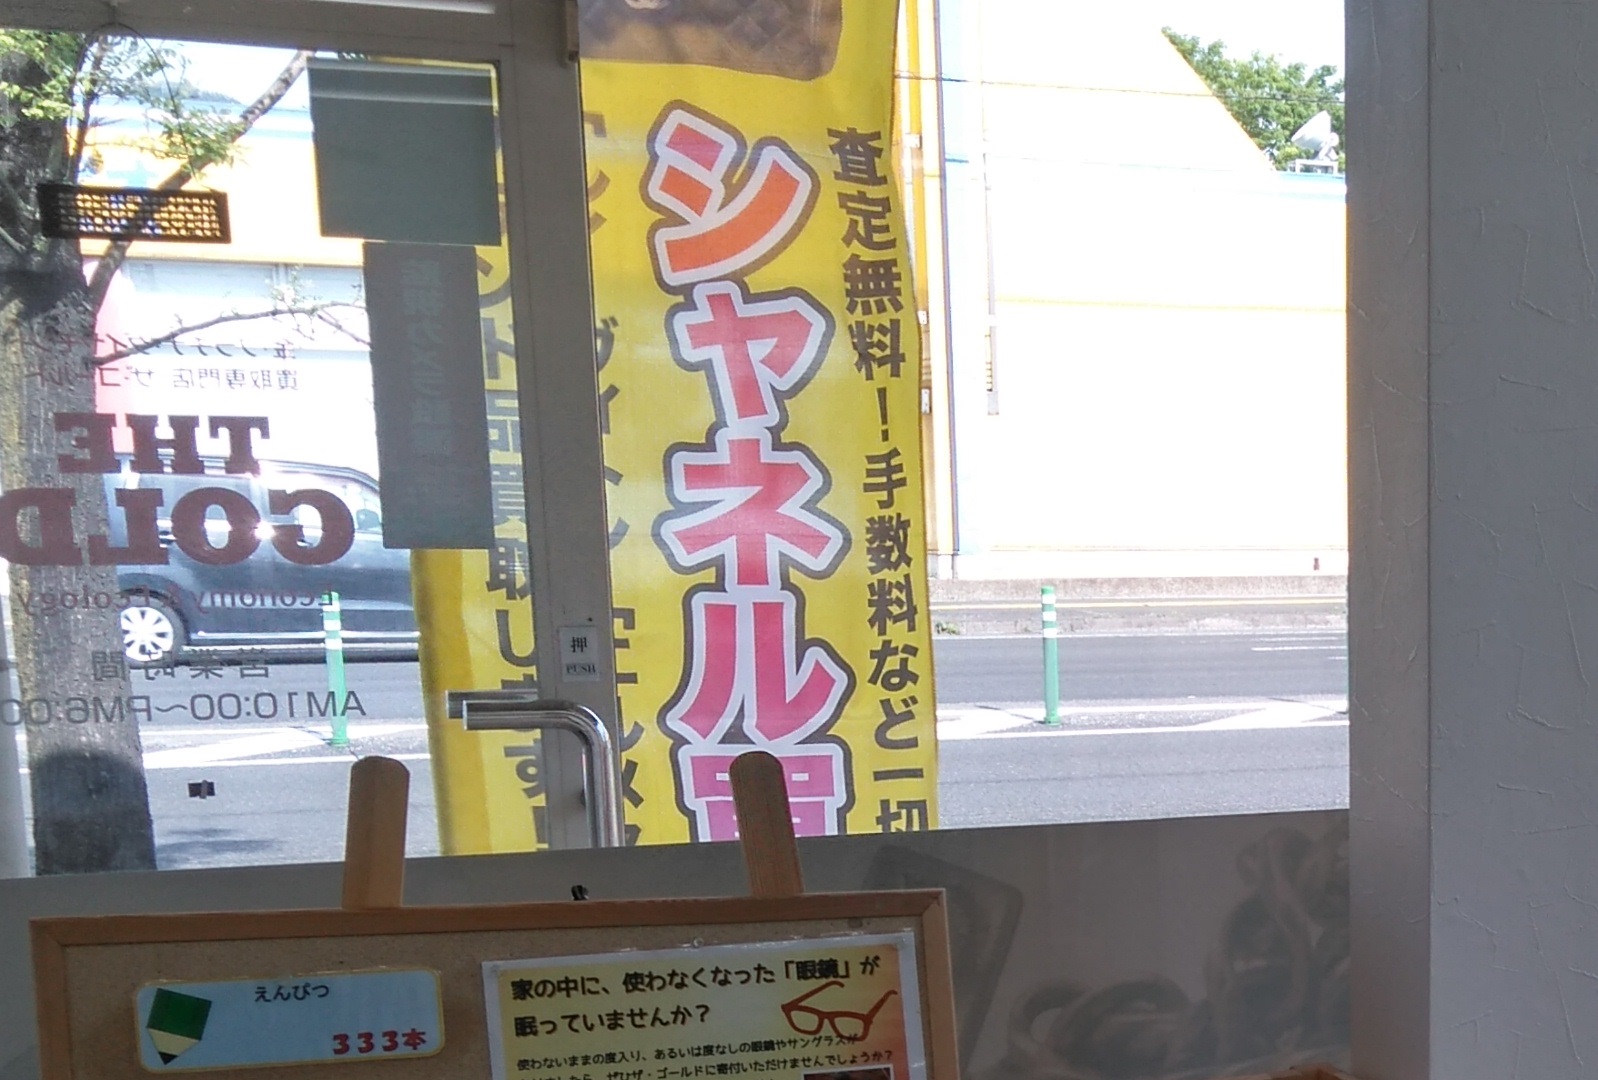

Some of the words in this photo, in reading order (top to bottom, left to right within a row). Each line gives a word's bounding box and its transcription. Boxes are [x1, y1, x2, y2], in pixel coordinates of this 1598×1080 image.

[571, 636, 587, 653] 押
[566, 663, 596, 674] PUSH
[510, 954, 882, 1001] 家の中に、使わなくなった「眼鏡」が
[253, 983, 330, 1003] えんぴつ
[514, 1003, 711, 1038] 眠っていませんか？
[332, 1028, 427, 1055] 333本
